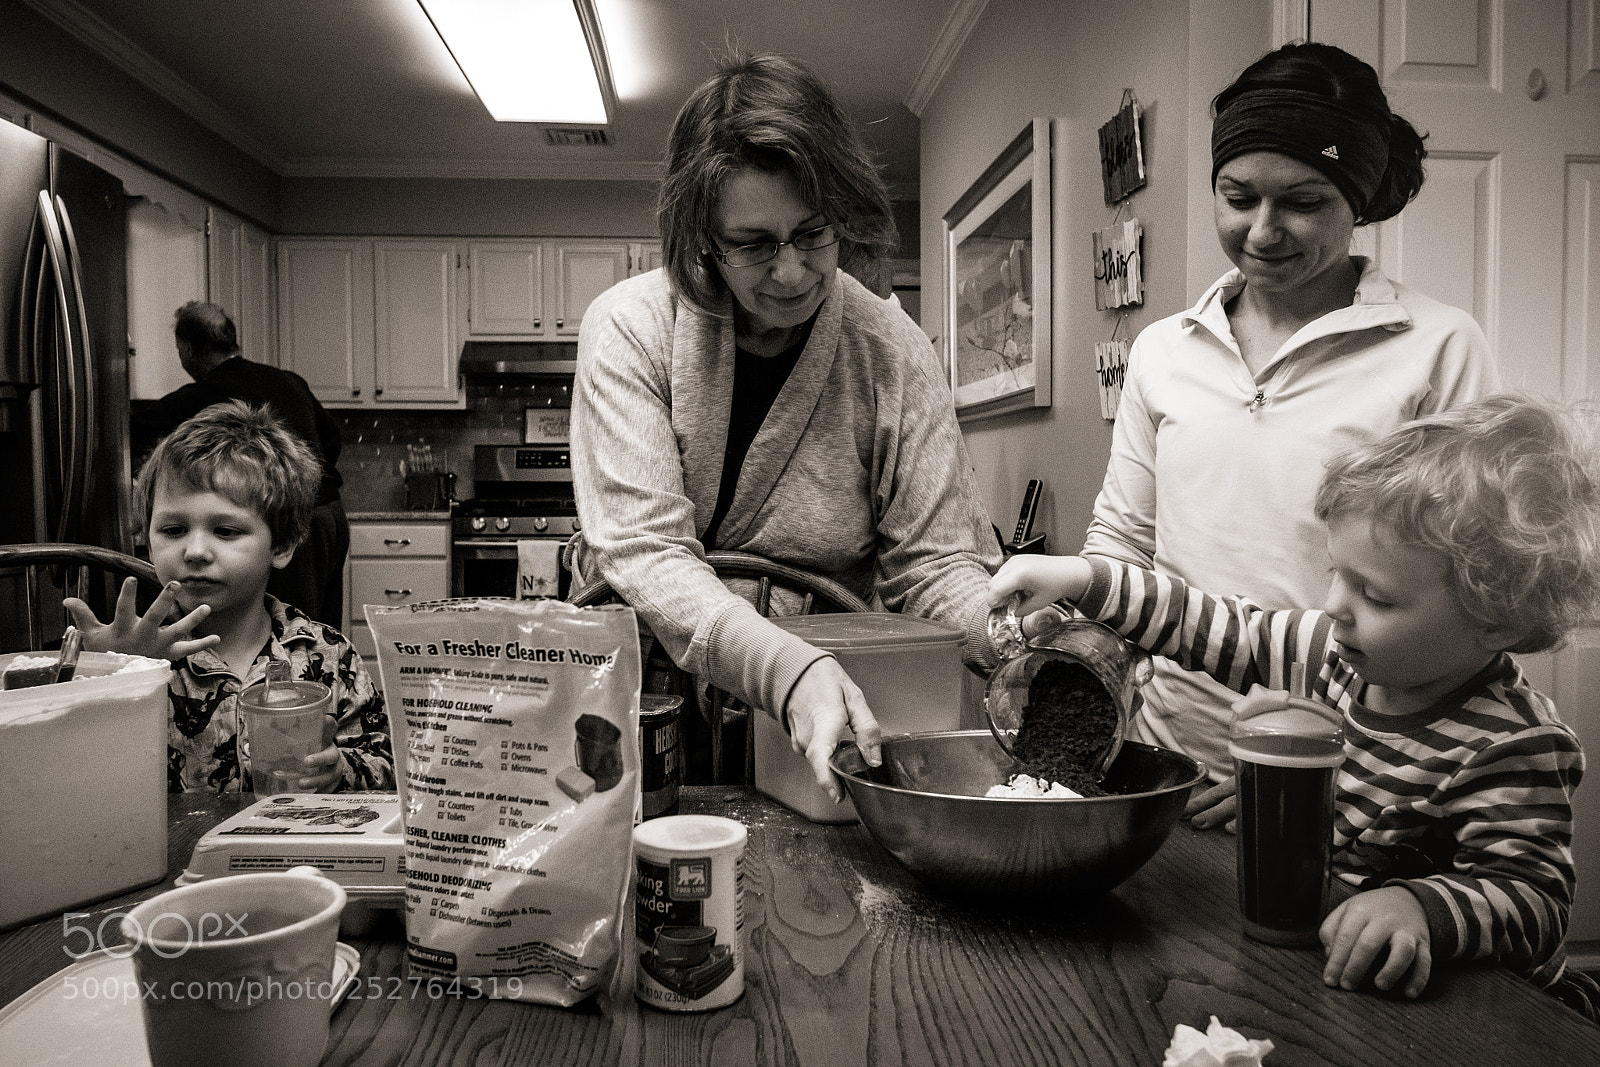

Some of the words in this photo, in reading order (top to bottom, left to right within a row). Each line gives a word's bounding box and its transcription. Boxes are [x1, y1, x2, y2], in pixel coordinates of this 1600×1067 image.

[1095, 248, 1135, 285] this
[522, 575, 534, 591] N
[394, 641, 422, 656] For
[427, 644, 438, 656] a
[442, 640, 501, 658] Fresher
[506, 641, 565, 663] Cleaner
[471, 670, 483, 679] Soda
[518, 674, 529, 682] and
[402, 698, 415, 708] FOR
[455, 701, 493, 713] CLEANING
[451, 735, 477, 747] Counters
[511, 741, 525, 751] Pots
[527, 742, 532, 751] &
[533, 742, 549, 752] Pans
[451, 746, 470, 757] Dishes
[511, 753, 532, 762] Ovens
[449, 757, 469, 768] Coffee
[470, 760, 484, 769] Pots
[511, 763, 548, 775] Microwaves
[428, 786, 444, 797] tough
[464, 790, 476, 799] and
[476, 791, 485, 799] lift
[486, 792, 495, 801] off
[495, 793, 507, 801] dirt
[507, 795, 519, 803] and
[447, 800, 475, 811] Counters
[509, 806, 523, 817] Tubs
[447, 811, 466, 822] Toilets
[431, 830, 469, 844] CLEANER
[471, 835, 506, 849] CLOTHES
[415, 839, 430, 849] liquid
[430, 842, 451, 854] laundry
[425, 851, 440, 862] liquid
[440, 855, 461, 865] laundry
[526, 867, 547, 878] clothes
[442, 873, 493, 892] DEODORIZING
[434, 885, 450, 895] odors
[488, 908, 520, 919] Disposals
